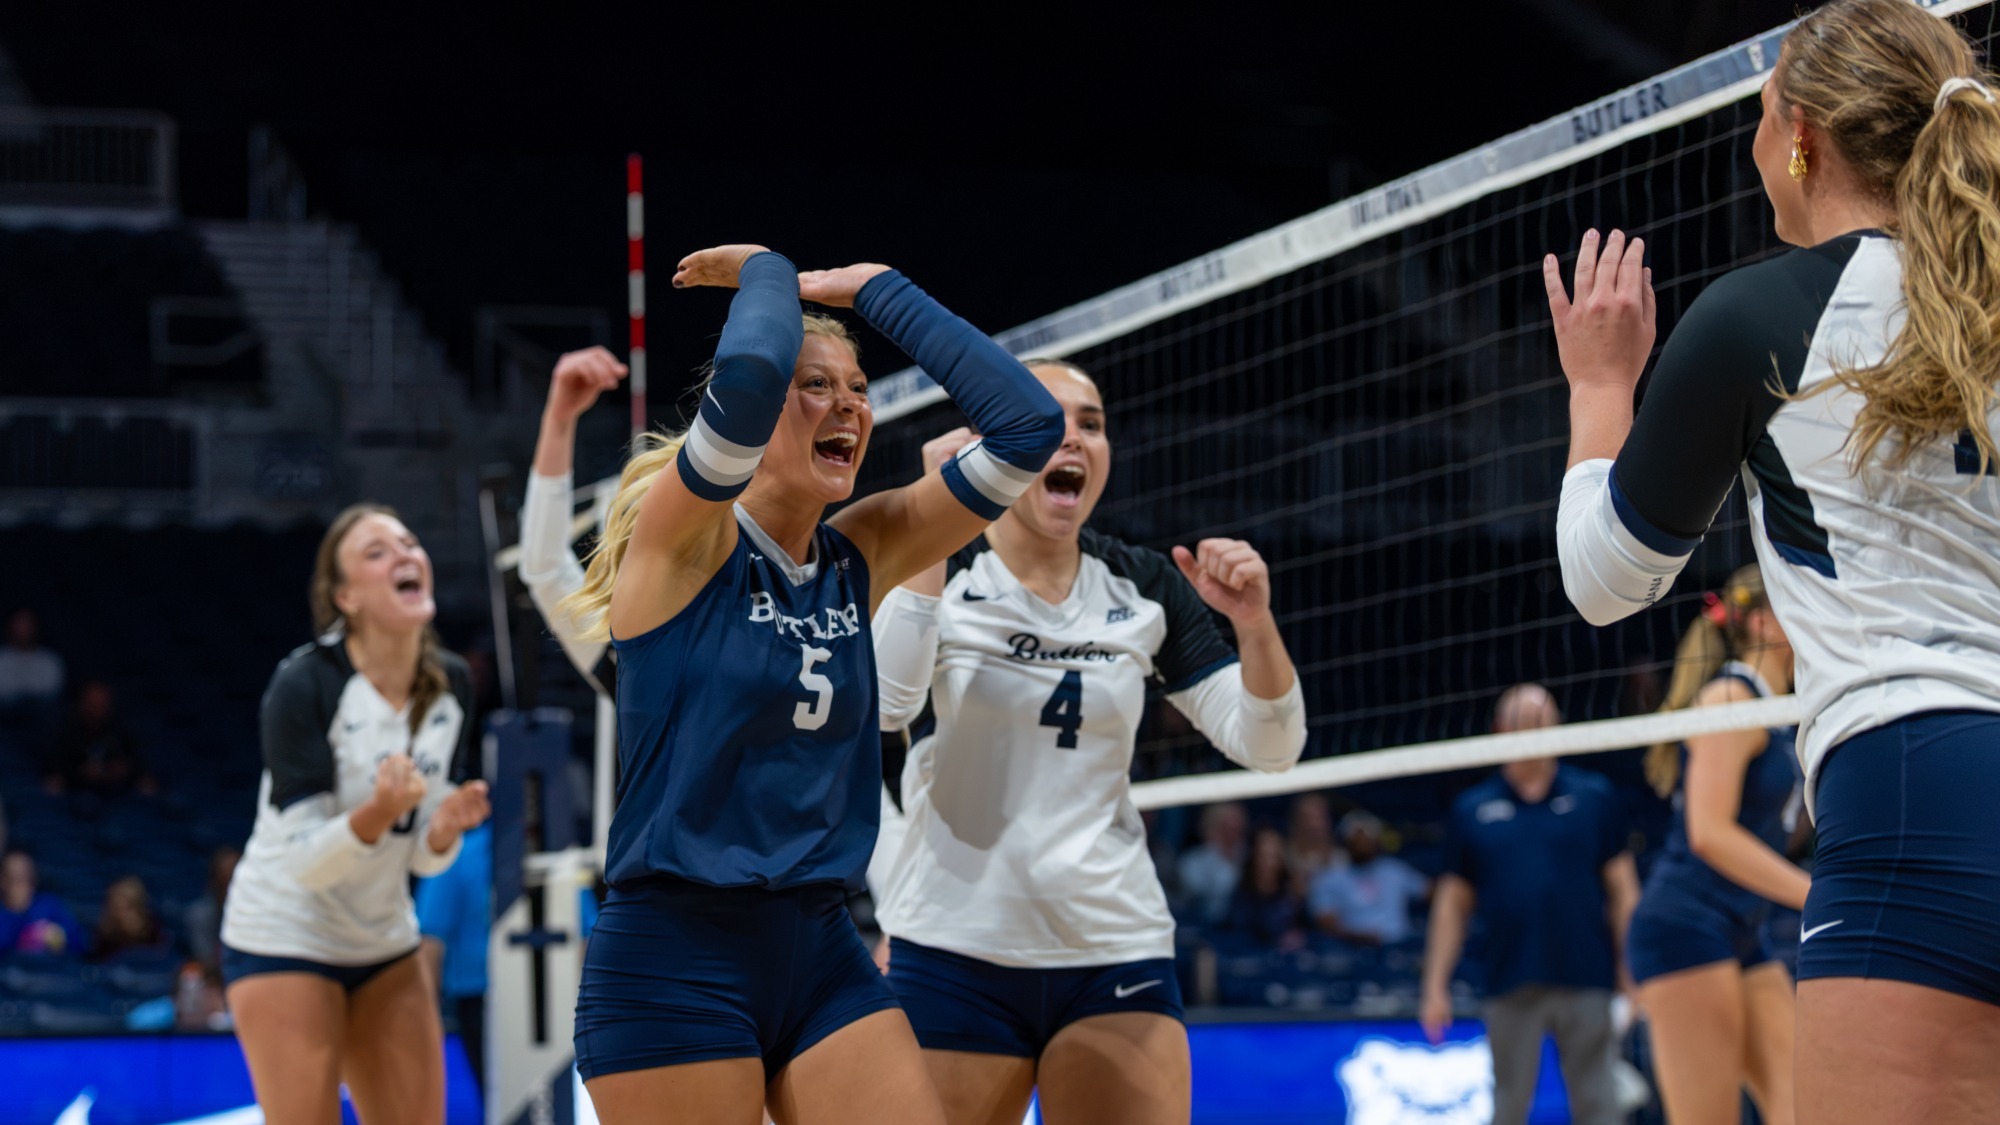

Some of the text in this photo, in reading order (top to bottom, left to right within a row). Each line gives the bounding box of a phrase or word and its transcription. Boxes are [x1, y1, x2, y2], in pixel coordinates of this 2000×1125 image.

[1572, 82, 1668, 143] BUTLER
[748, 591, 860, 641] BUTLER
[1005, 632, 1117, 663] Butler
[792, 643, 834, 731] 5
[1038, 669, 1083, 750] 4
